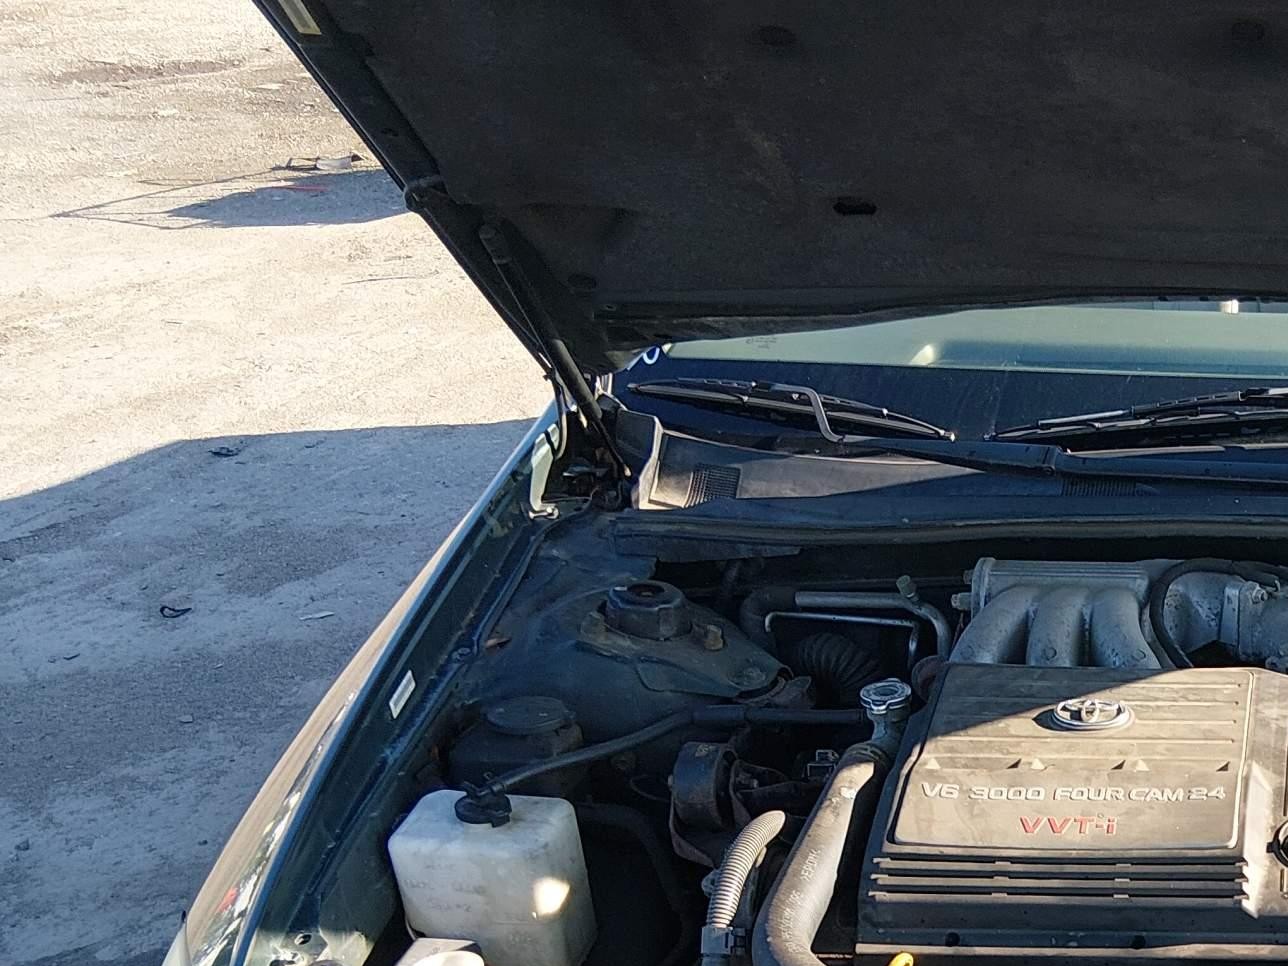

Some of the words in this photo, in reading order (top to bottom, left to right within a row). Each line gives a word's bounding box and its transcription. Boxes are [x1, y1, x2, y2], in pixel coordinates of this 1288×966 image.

[921, 783, 959, 798] V6
[969, 786, 1045, 801] 3000
[1053, 786, 1123, 801] FOUR
[1129, 786, 1183, 802] CAM
[1187, 785, 1226, 801] 24
[1019, 814, 1118, 836] VVT-i
